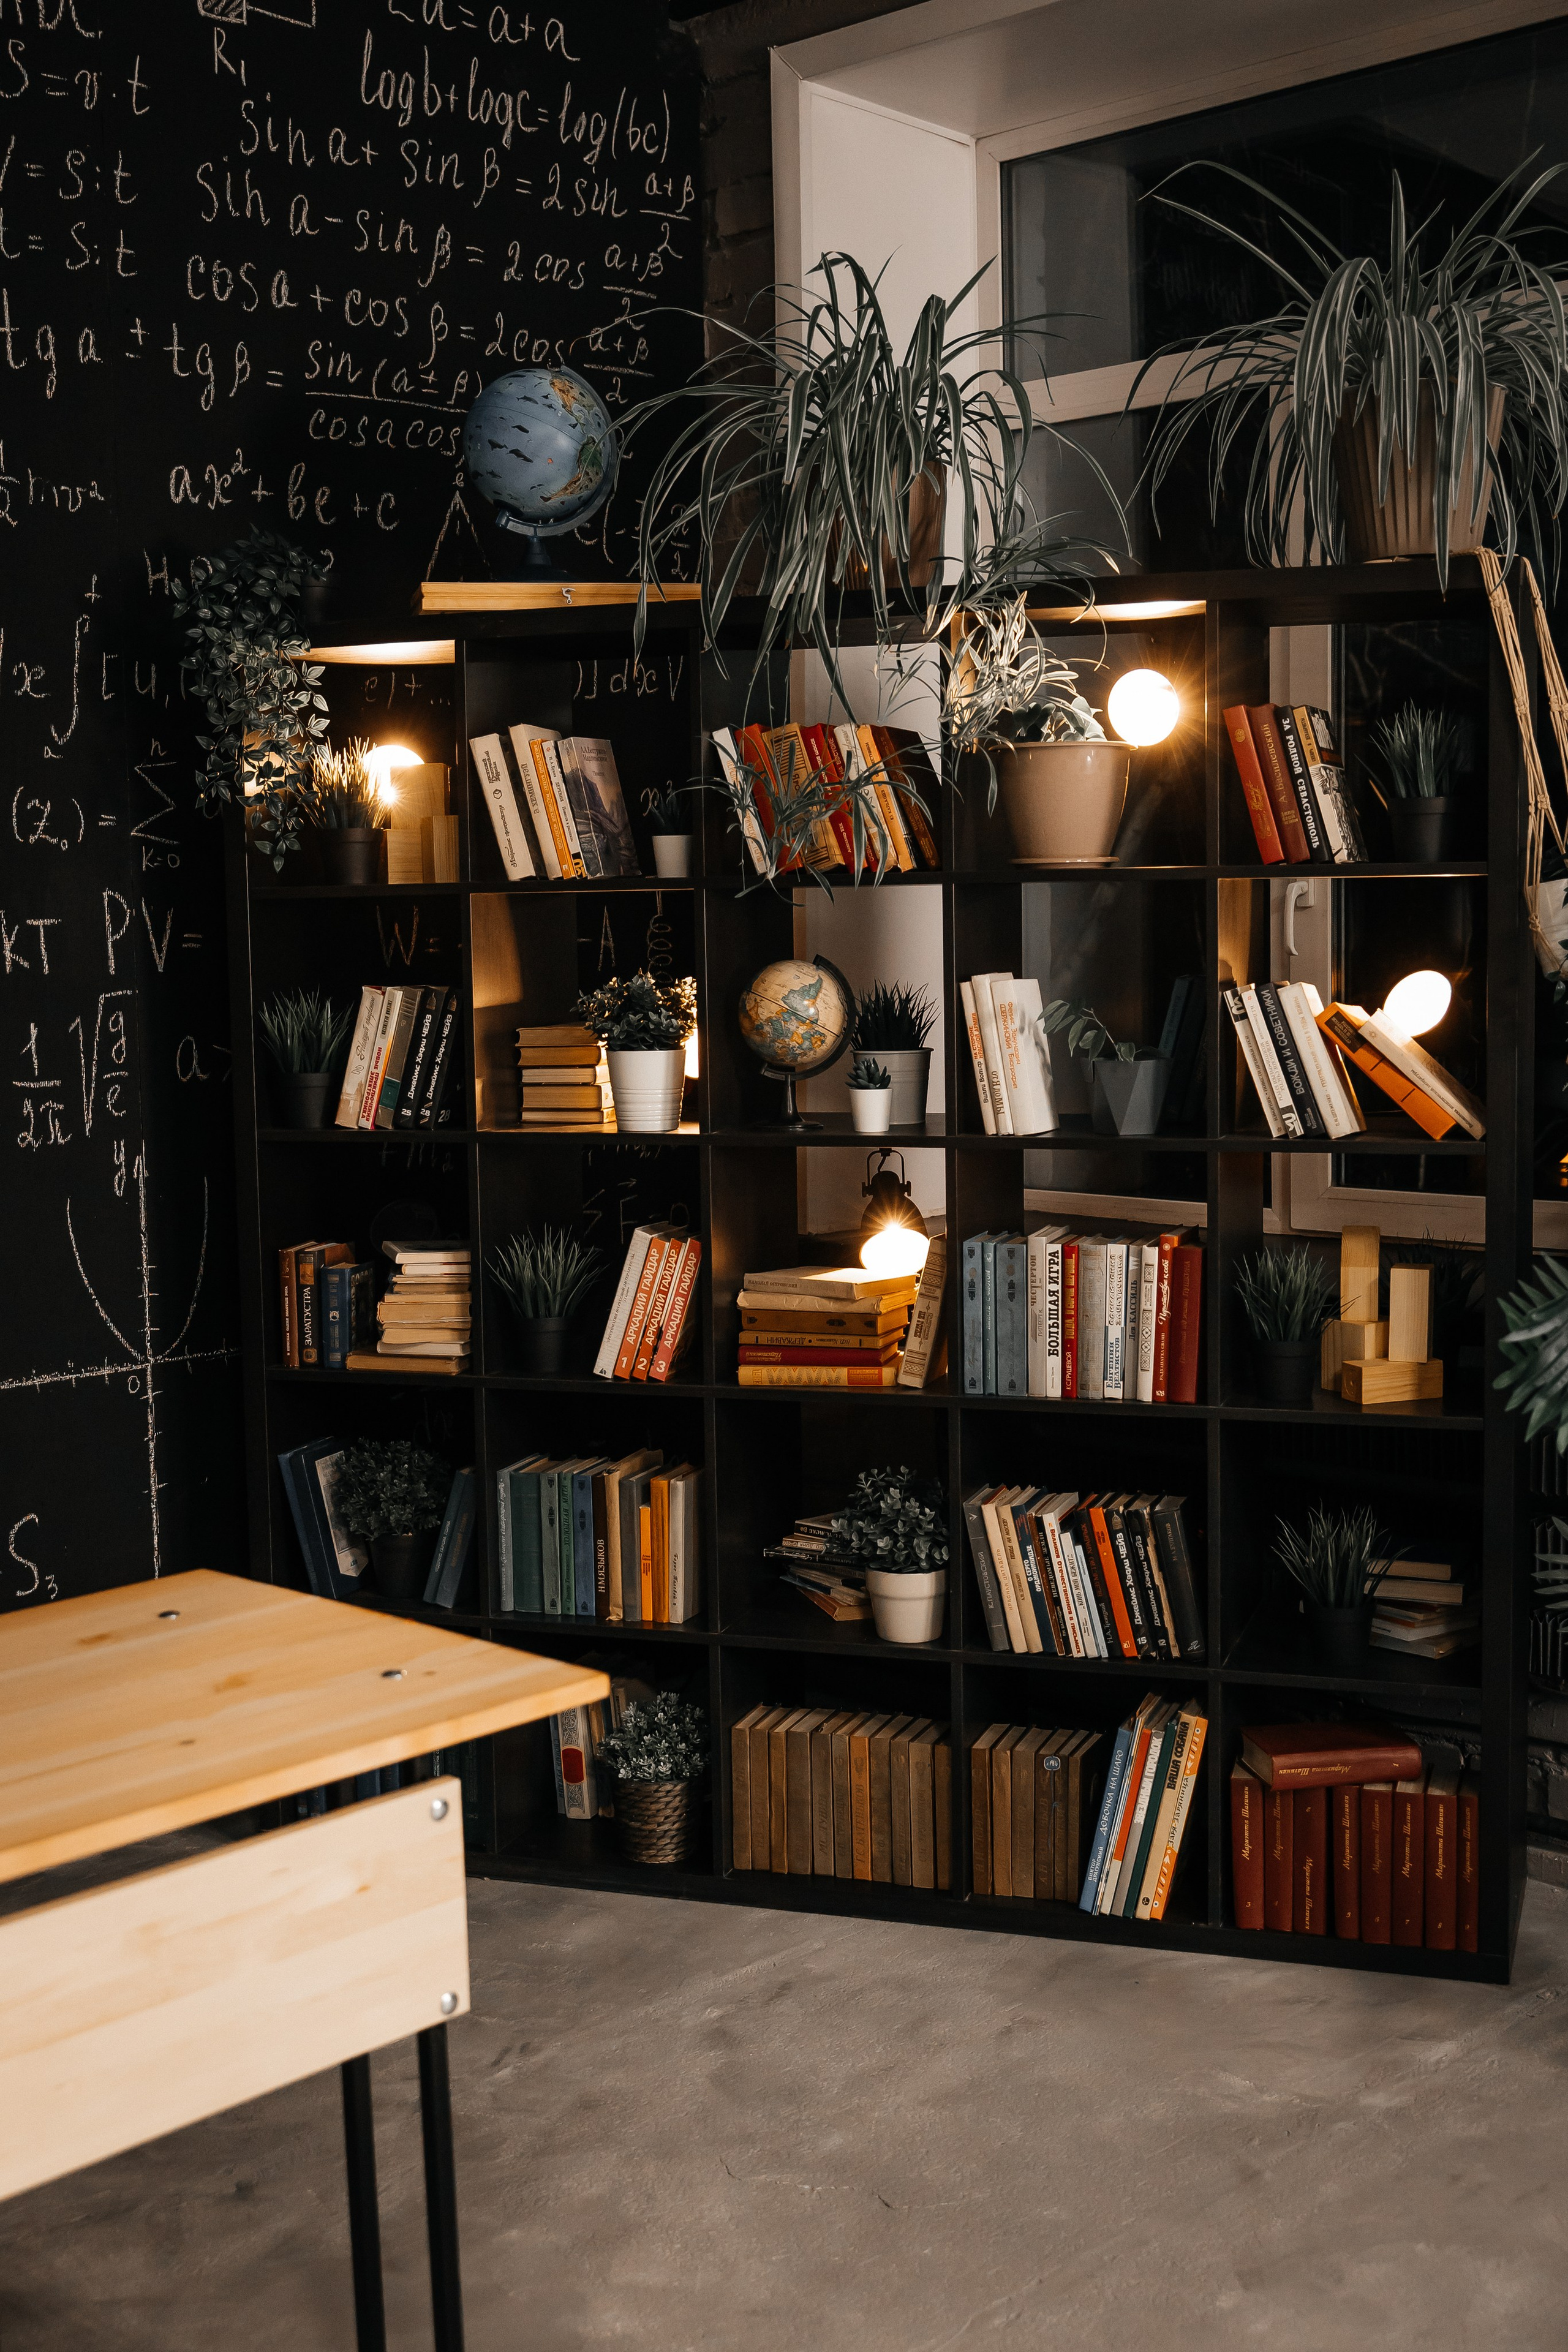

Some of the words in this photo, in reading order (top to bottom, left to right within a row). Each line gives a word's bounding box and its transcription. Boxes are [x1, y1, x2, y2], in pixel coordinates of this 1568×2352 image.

[810, 737, 819, 755] ШОССЕ
[827, 736, 842, 764] ВОСТОКЕ
[1260, 723, 1284, 790] Василевский
[520, 763, 538, 807] ХЕМИНГУЭЙ
[837, 765, 845, 774] НА
[1281, 717, 1291, 731] ЗА
[1286, 734, 1303, 774] РОДНОЙ
[1296, 778, 1320, 849] СЕВАСТОПОЛЬ
[555, 781, 564, 802] ДЕРЕВНЯ
[1276, 791, 1287, 805] А.
[971, 1012, 979, 1033] АРМИИ
[1000, 1003, 1012, 1049] ДЗЕРЖИНСКИЙ
[1261, 988, 1288, 1047] СОВЕТНИКИ
[373, 1047, 382, 1069] НОВЫЕ
[407, 1063, 421, 1099] Джеймс
[420, 1012, 432, 1038] ЧЕЙЗ
[426, 1063, 440, 1099] Джеймс
[440, 1012, 453, 1038] ЧЕЙЗ
[1281, 1047, 1292, 1057] И
[976, 1060, 985, 1082] Вольф
[1285, 1058, 1305, 1095] ВОЖДИ
[360, 1071, 375, 1119] ЭЛЕКТРОНИКА
[364, 1072, 380, 1121] ПРИКЛЮЧЕНИЯ
[1047, 1250, 1058, 1285] ИГРА
[1182, 1260, 1191, 1297] ПУШКИНА
[625, 1291, 649, 1345] АРКАДИЙ
[639, 1246, 662, 1291] ГАЙДАР
[644, 1293, 666, 1346] АРКАДИЙ
[658, 1248, 679, 1292] ГАЙДАР
[662, 1295, 687, 1349] АРКАДИЙ
[677, 1251, 699, 1295] ГАЙДАР
[1129, 1279, 1137, 1323] КАССИЛЬ
[302, 1286, 312, 1346] ЗАРАТУСТРА
[1047, 1288, 1059, 1357] БОЛЬШАЯ
[766, 1336, 806, 1345] ДЕРЖАВИН
[621, 1357, 628, 1368] 1
[638, 1357, 647, 1370] 2
[656, 1360, 666, 1373] 3
[1105, 1341, 1114, 1388] ЕВГЕНИЙ
[1114, 1337, 1122, 1389] ВЕЛТИСТОВ
[1001, 1517, 1011, 1537] МОСКВУ
[1037, 1531, 1048, 1555] ЗЕМЛИ
[1080, 1523, 1093, 1555] ХРАБРЫХ
[1115, 1532, 1128, 1559] ЧЕЙЗ
[995, 1547, 1008, 1581] ЦИТАДЕЛЬ
[1133, 1535, 1145, 1560] ЧЕЙЗ
[977, 1550, 995, 1609] К.ПАУСТОВСКИЙ
[1023, 1558, 1031, 1576] СЕРГО
[1025, 1545, 1042, 1592] ОРДЖОНИКИДЗЕ
[1043, 1555, 1058, 1598] НЕВЕДОМЫЕ
[1071, 1577, 1081, 1591] МОЙ
[1050, 1528, 1062, 1559] Великая
[1057, 1560, 1074, 1615] Отечественная
[1070, 1621, 1082, 1654] письмах
[1128, 1587, 1142, 1626] Джеймс
[1147, 1588, 1161, 1627] Джеймс
[1056, 1605, 1065, 1629] БАЛАНДИН
[1144, 1735, 1163, 1777] ГОРОДОК
[1172, 1721, 1189, 1758] СОБАКА
[1108, 1776, 1118, 1790] НА
[1166, 1758, 1182, 1790] ВАША
[1278, 1767, 1310, 1777] Шагинян
[1311, 1763, 1351, 1774] Мариэтта
[1242, 1820, 1251, 1860] Мариэтта
[1342, 1829, 1352, 1869] Мариэтта
[1401, 1836, 1412, 1877] Мариэтта
[1435, 1838, 1446, 1879] Мариэтта
[1087, 1858, 1096, 1880] ВИКТОР
[1091, 1845, 1104, 1882] ДРАГУНСКИЙ
[1303, 1856, 1313, 1895] Мариэтта
[1462, 1841, 1472, 1883] Мариэтта
